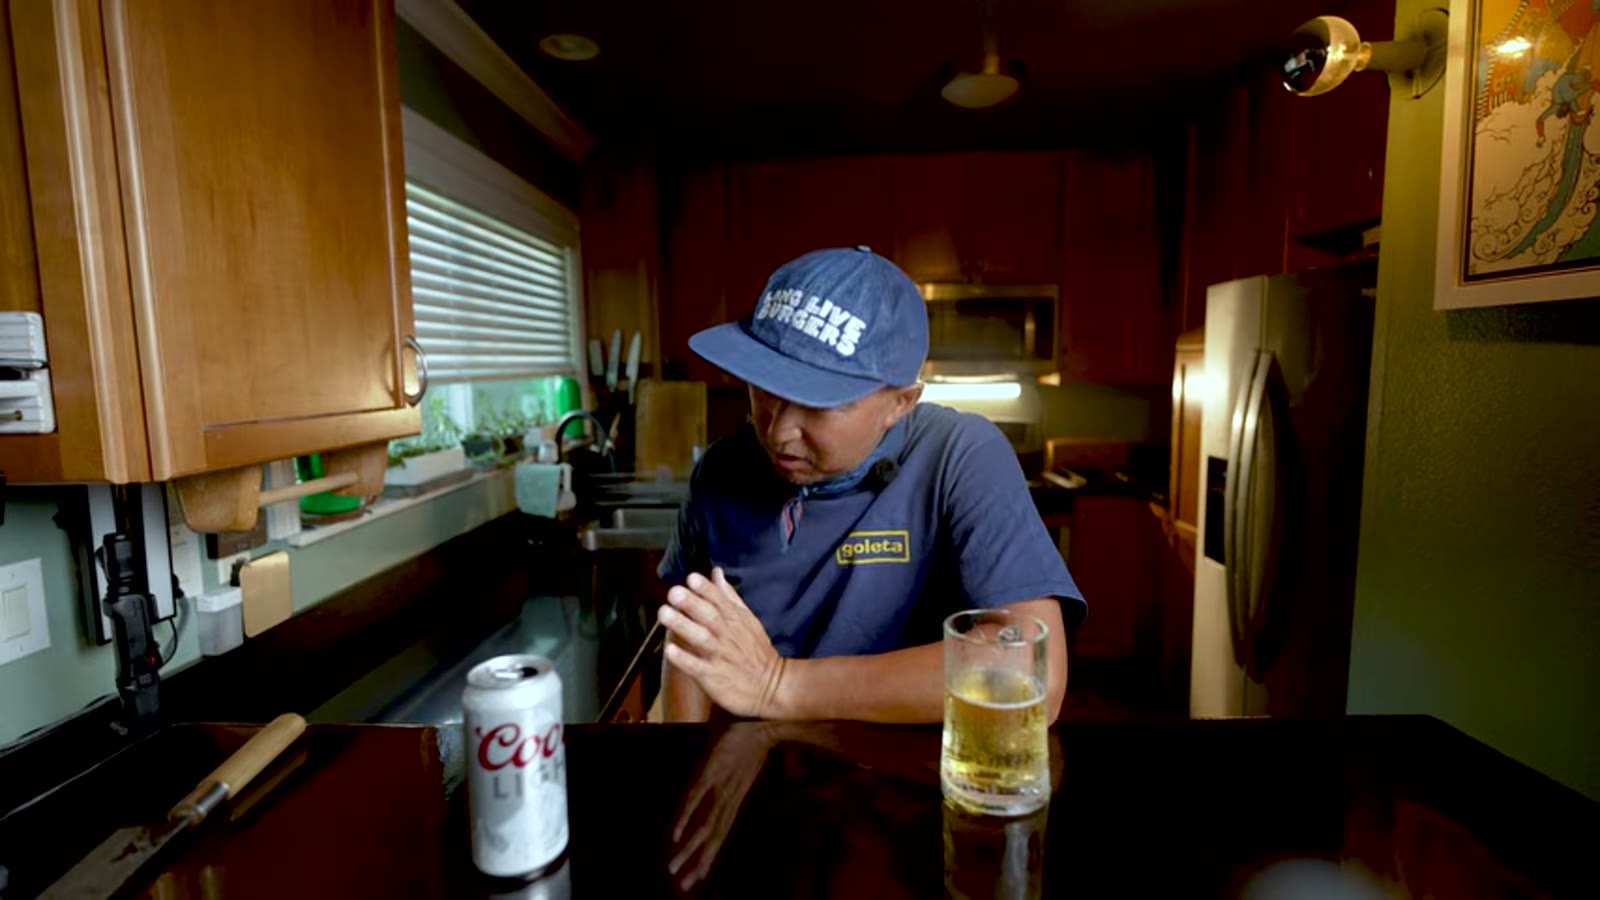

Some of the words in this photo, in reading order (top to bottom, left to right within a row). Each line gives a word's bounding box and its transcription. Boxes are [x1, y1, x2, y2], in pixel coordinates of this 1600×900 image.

[757, 301, 856, 356] BURGERS
[805, 295, 867, 345] LIVE
[842, 539, 902, 558] goleta
[475, 722, 565, 772] Coo
